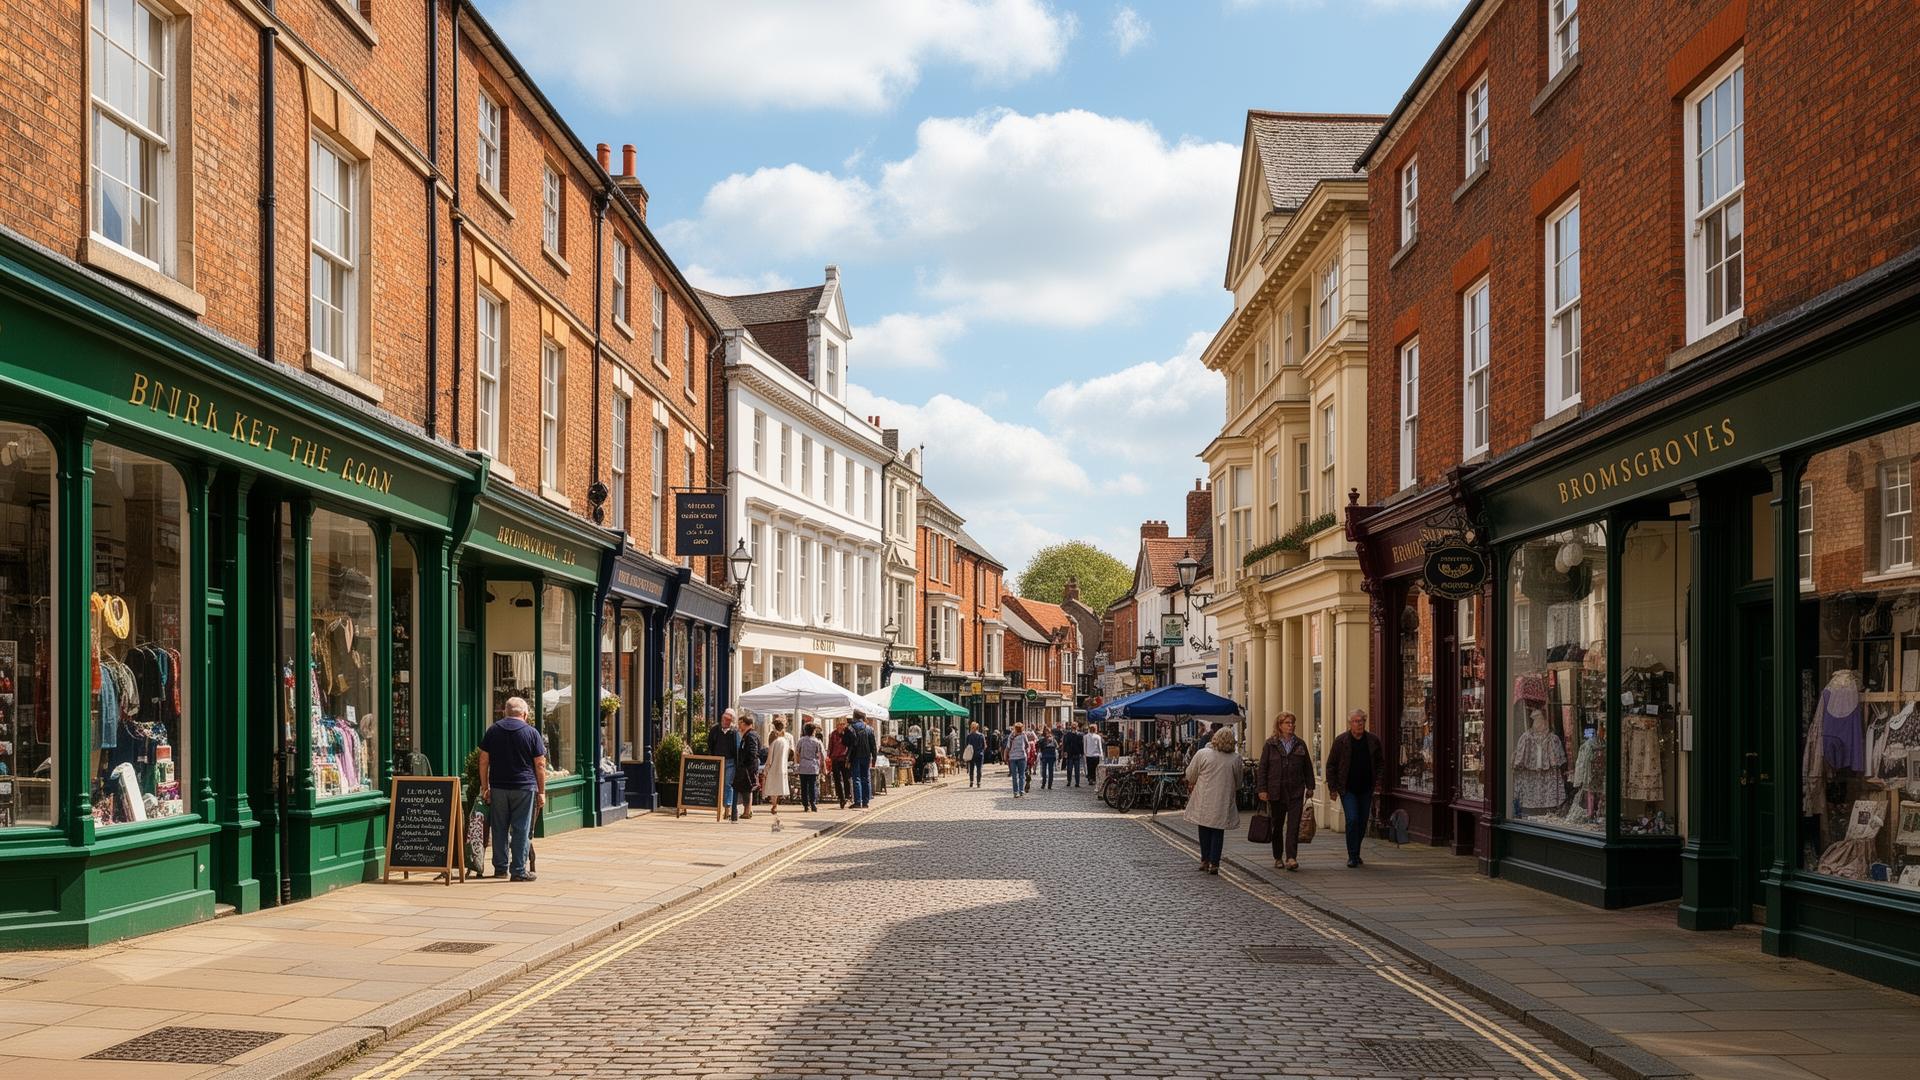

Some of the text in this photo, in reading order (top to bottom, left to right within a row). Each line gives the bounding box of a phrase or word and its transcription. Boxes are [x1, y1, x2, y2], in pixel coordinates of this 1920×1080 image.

[229, 410, 279, 451] KET
[289, 435, 331, 473] THE
[1558, 418, 1736, 504] BROMSGROVES
